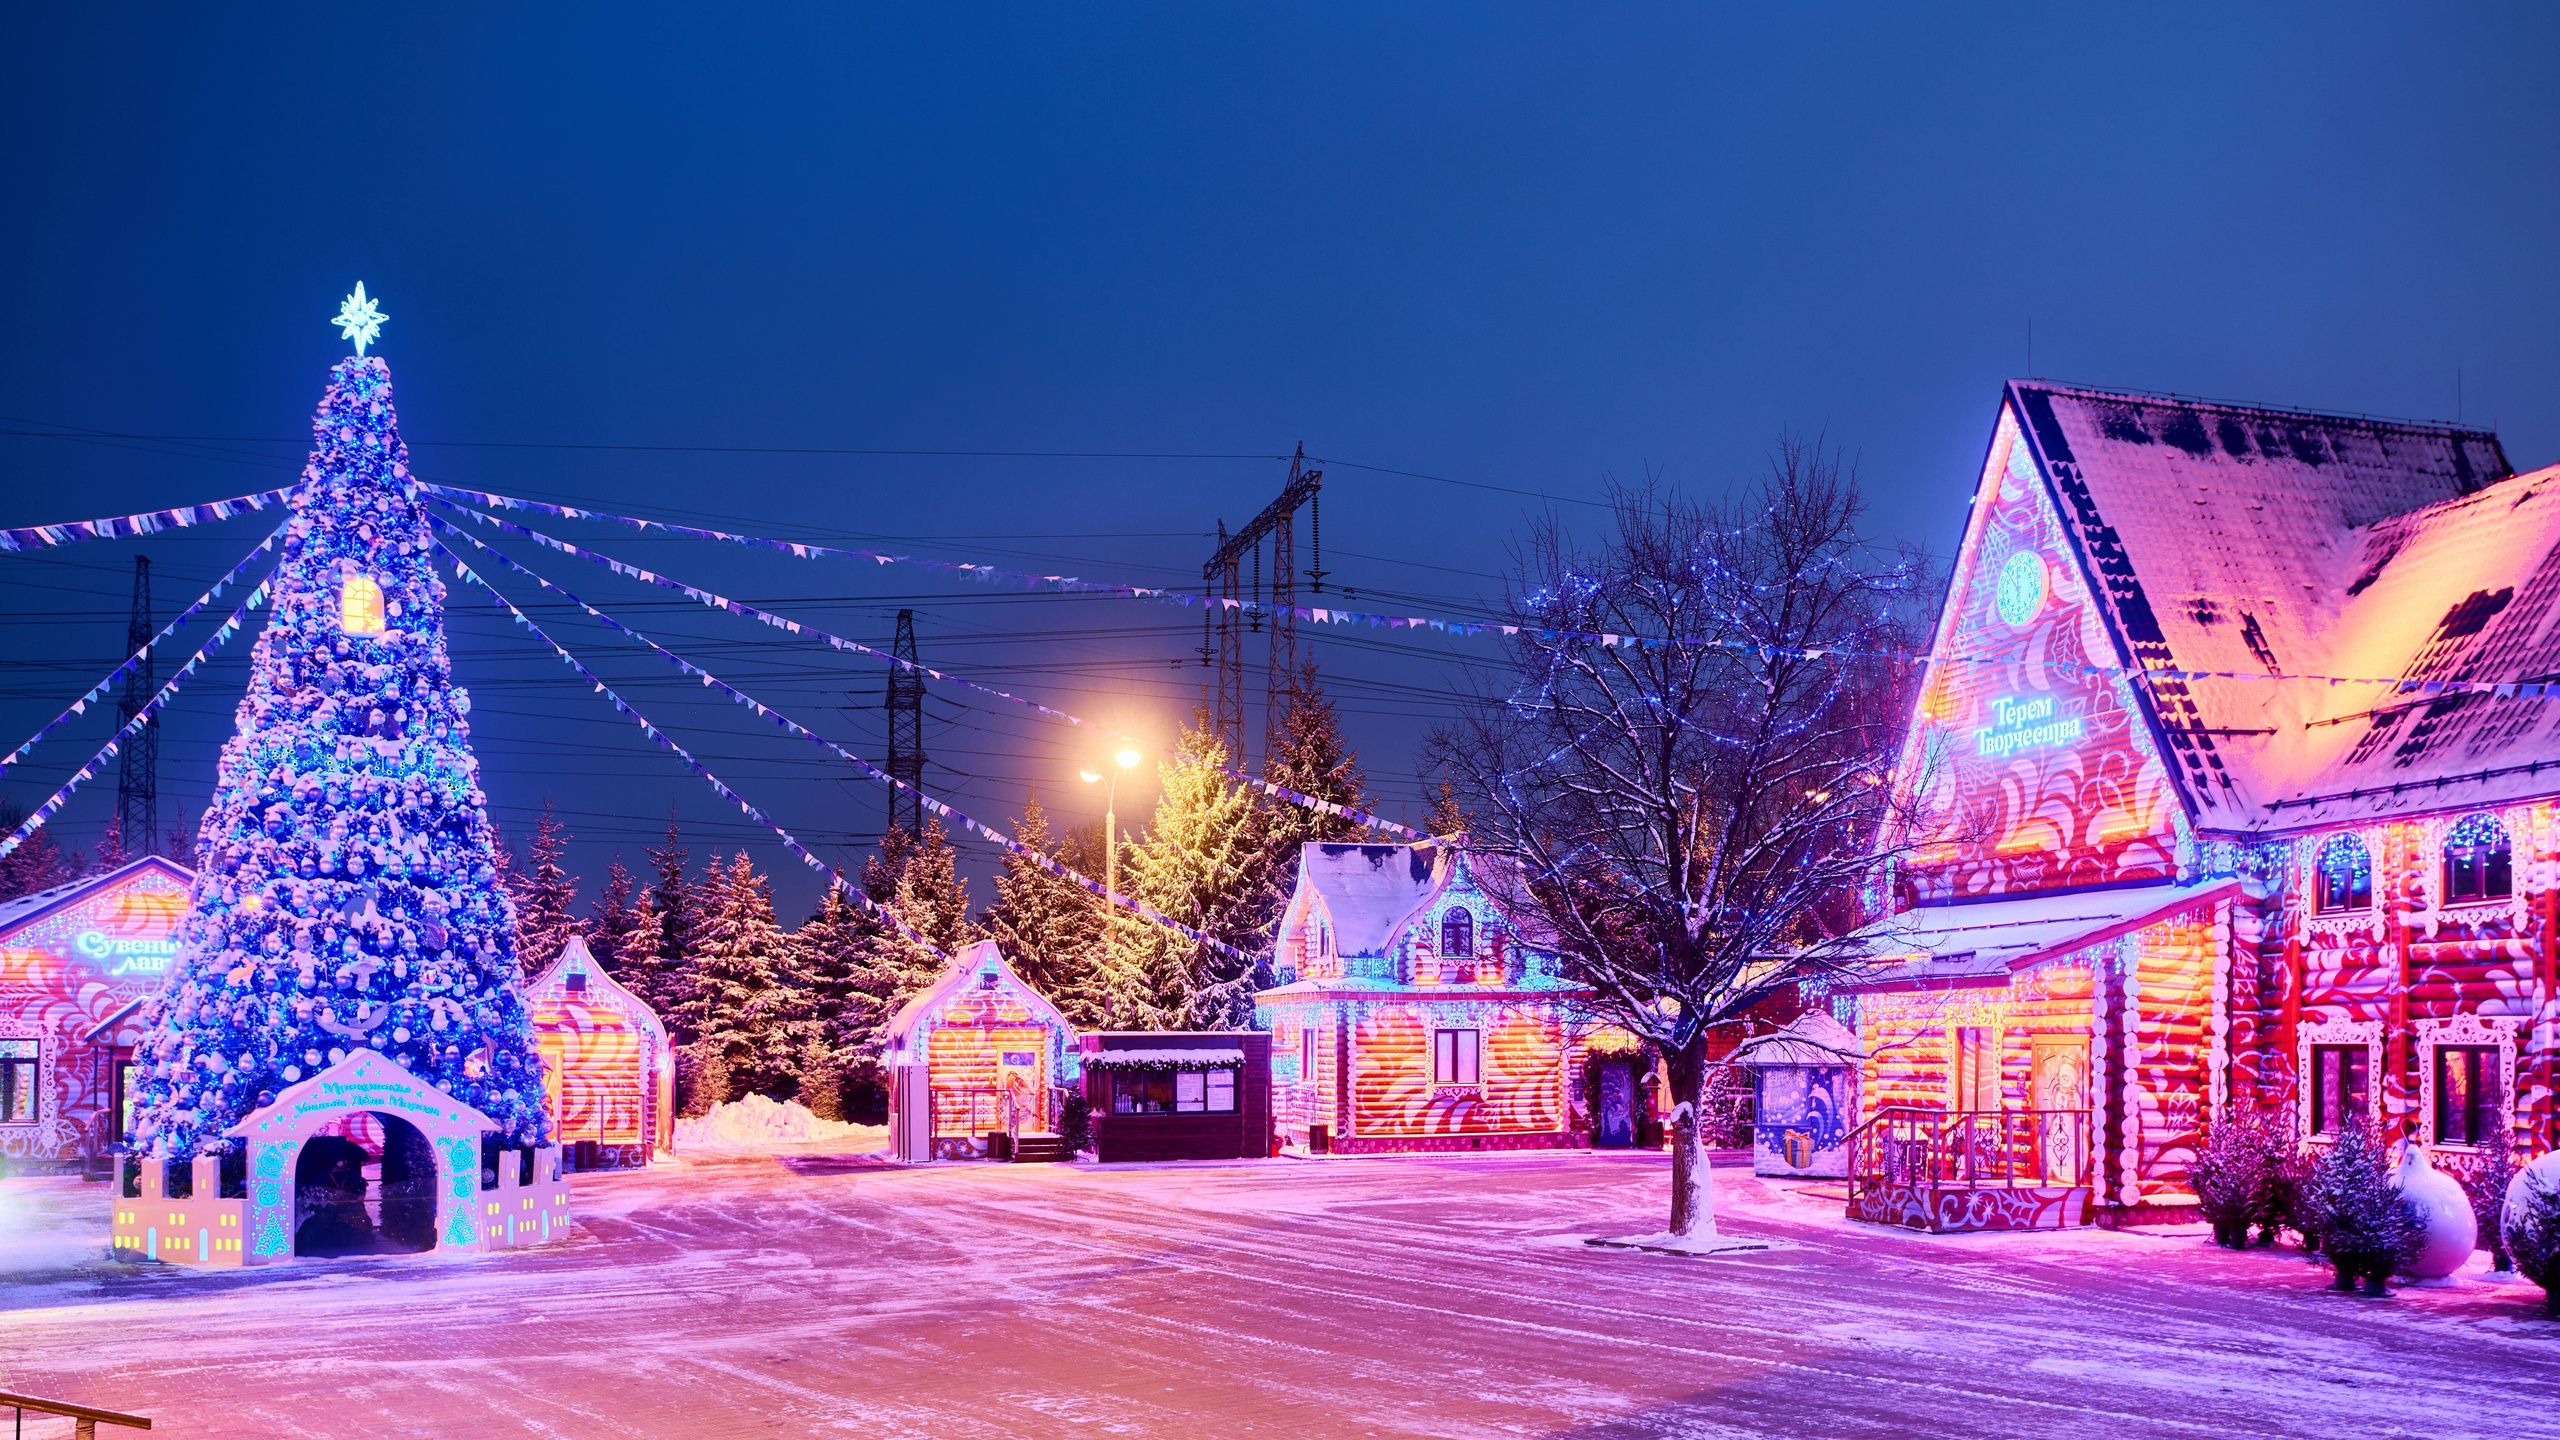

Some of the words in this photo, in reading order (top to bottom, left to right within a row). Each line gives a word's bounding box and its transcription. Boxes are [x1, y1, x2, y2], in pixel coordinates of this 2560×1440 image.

[1991, 697, 2053, 729] Терем
[1973, 718, 2081, 757] Творчества
[111, 955, 172, 975] лав
[319, 1081, 412, 1096] Московская
[349, 1094, 385, 1107] Деда
[387, 1094, 441, 1117] Мороза
